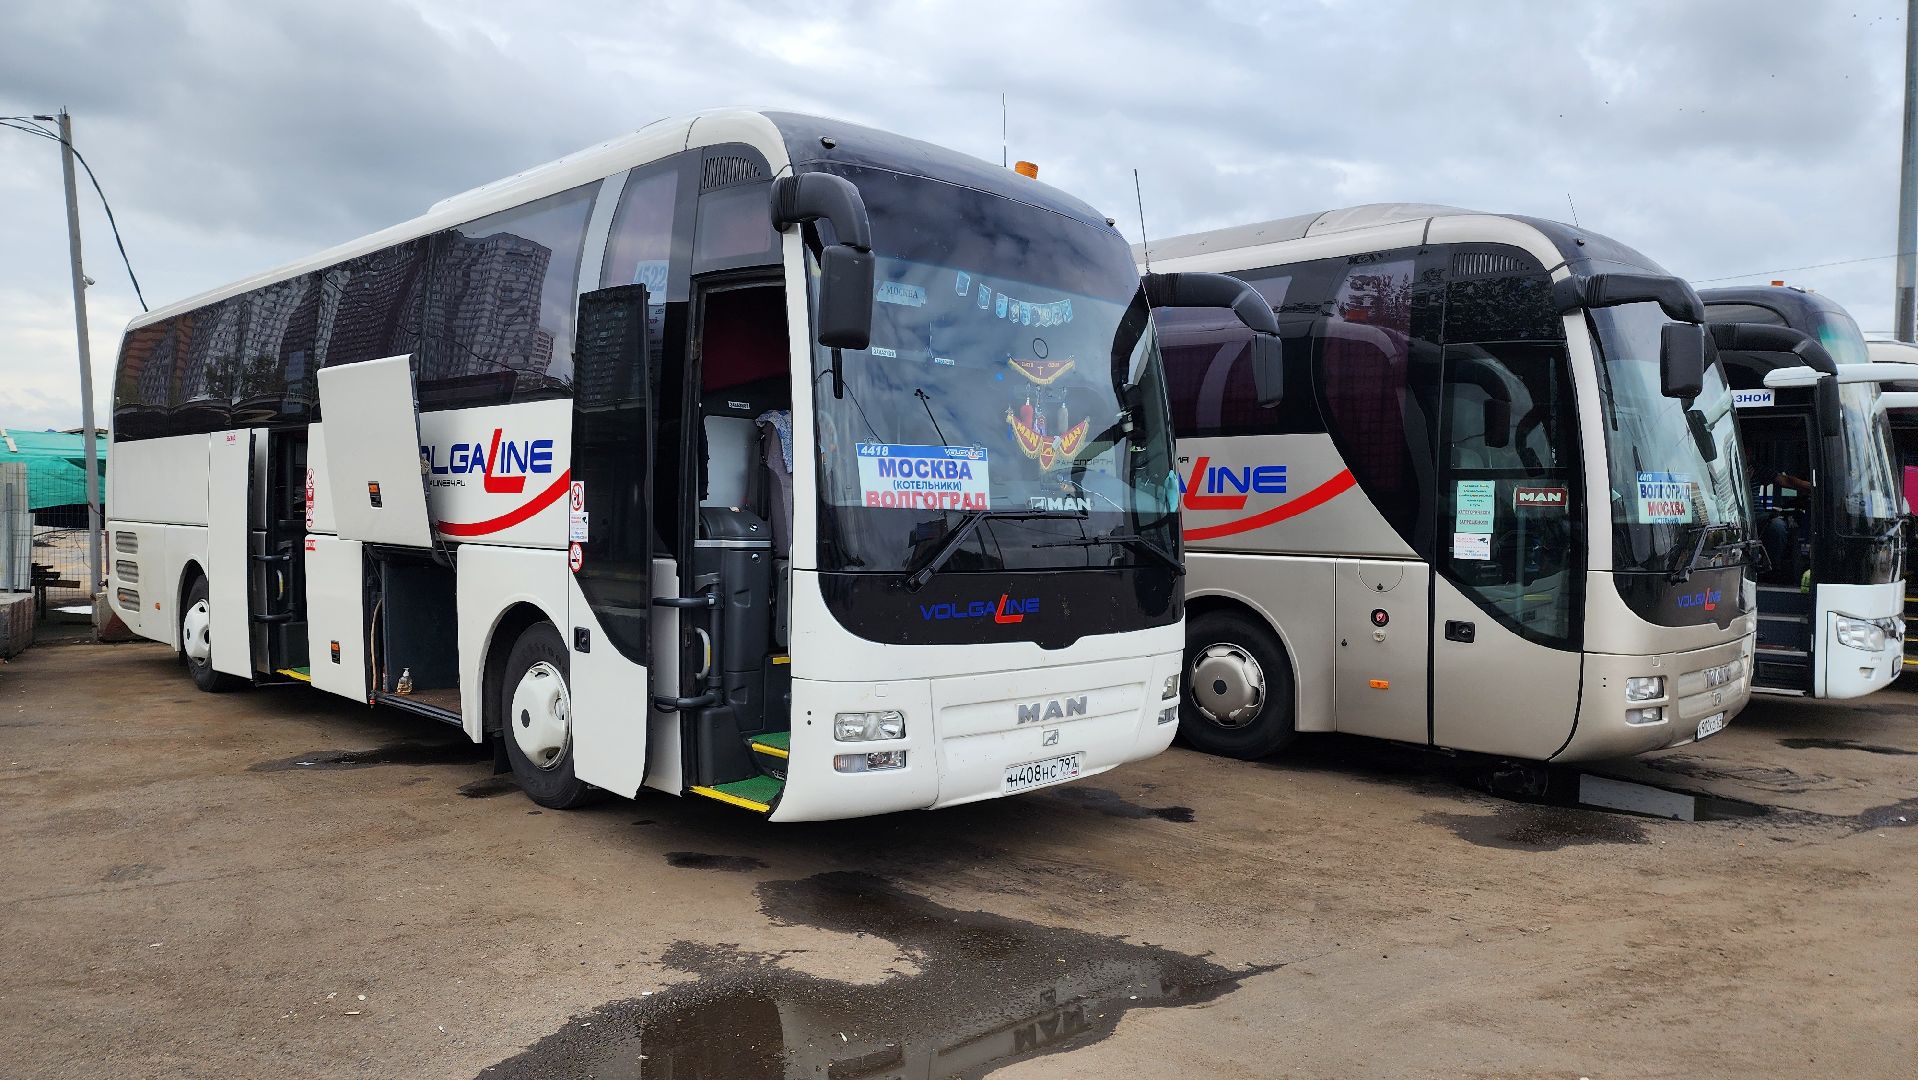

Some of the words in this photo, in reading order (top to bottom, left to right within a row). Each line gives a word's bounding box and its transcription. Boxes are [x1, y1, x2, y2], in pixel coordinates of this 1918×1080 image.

[1733, 391, 1771, 402] ЗНОЙ
[1016, 421, 1039, 447] MAN
[1061, 427, 1082, 451] MAN
[861, 445, 889, 456] 4418
[878, 458, 973, 480] МОСКВА
[893, 479, 962, 491] (КОТЕЛЬНИКИ)
[1640, 483, 1690, 500] ВОЛГОГРАД
[866, 490, 987, 510] ВОЛГОГРАД
[1047, 496, 1092, 511] MAN
[1519, 492, 1562, 502] MAN
[1647, 501, 1686, 516] МОСКВА
[919, 594, 1040, 624] VOLGALINE
[1017, 696, 1088, 725] MAN
